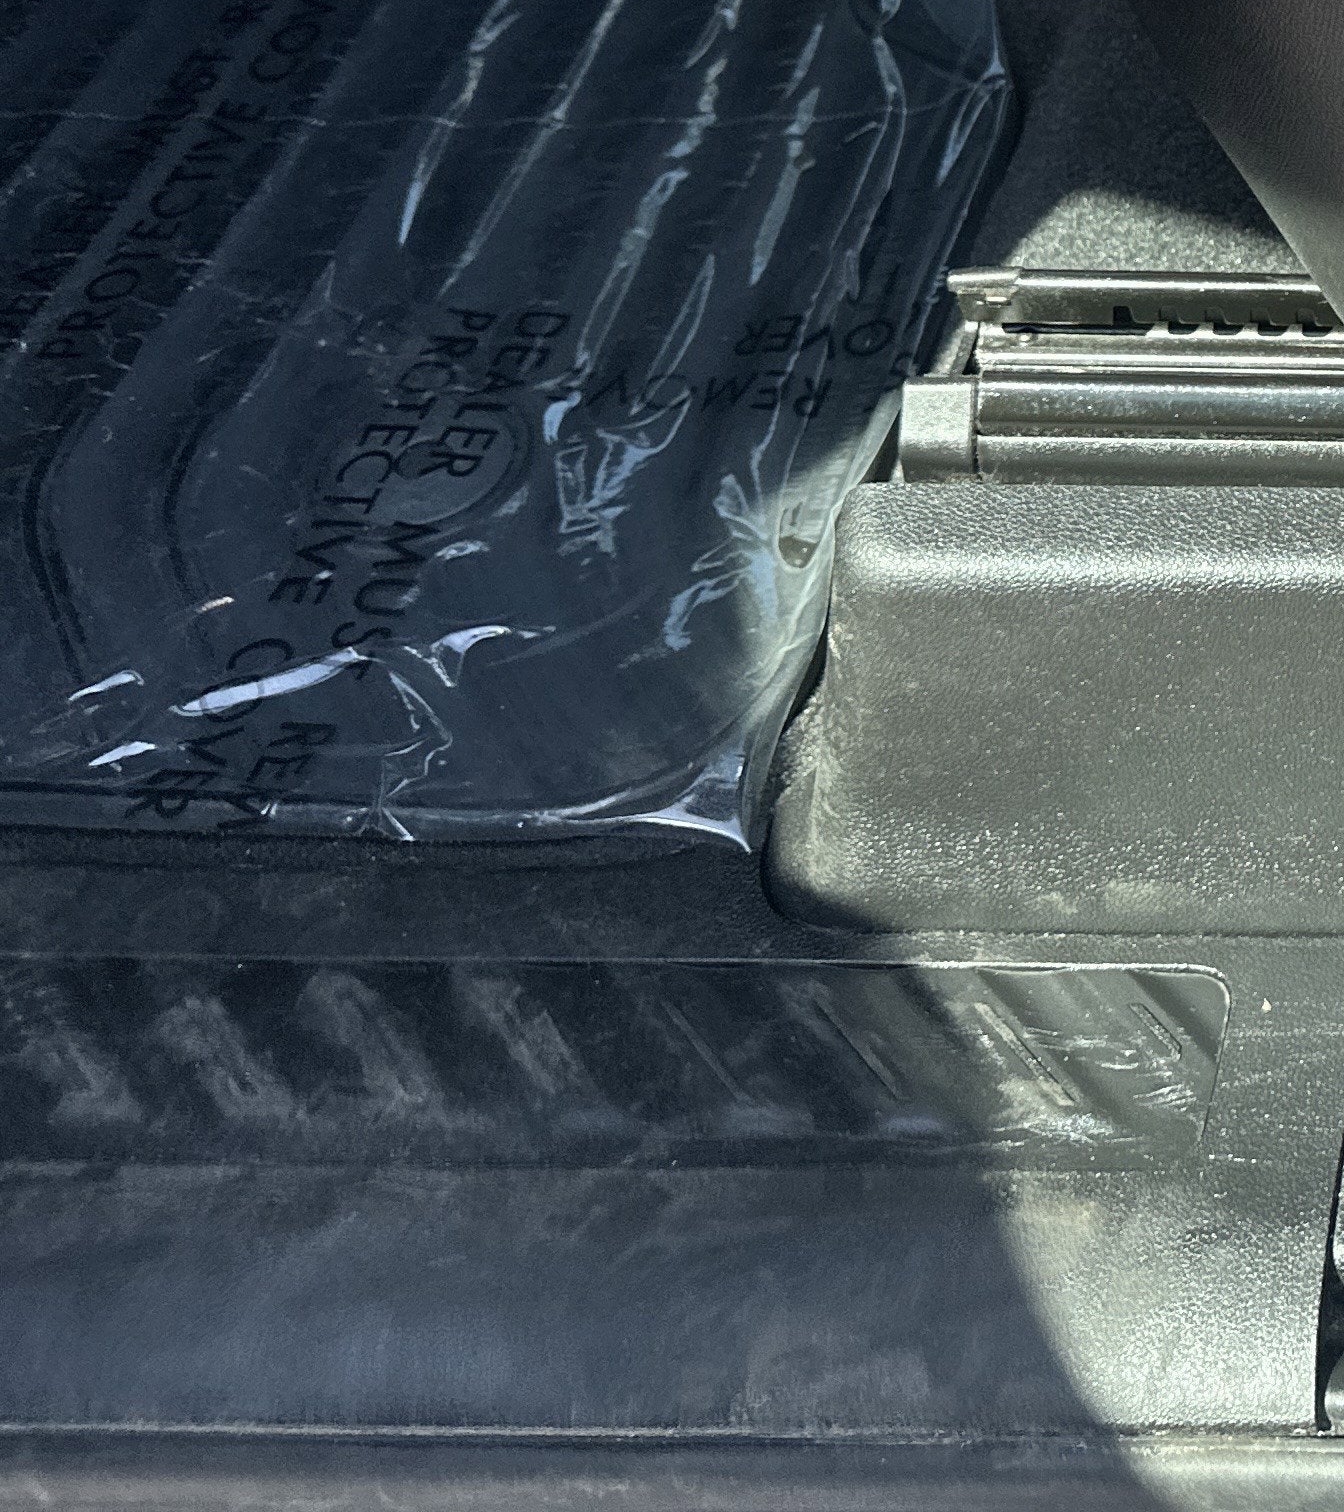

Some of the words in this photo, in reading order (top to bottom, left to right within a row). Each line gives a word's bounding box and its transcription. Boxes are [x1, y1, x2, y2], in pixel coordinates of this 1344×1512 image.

[35, 98, 272, 360] PROTECTIVE
[267, 306, 498, 607] PROTECTIVE
[421, 308, 571, 478] DEALER
[570, 370, 833, 421] REMOV
[122, 634, 296, 821] COVER
